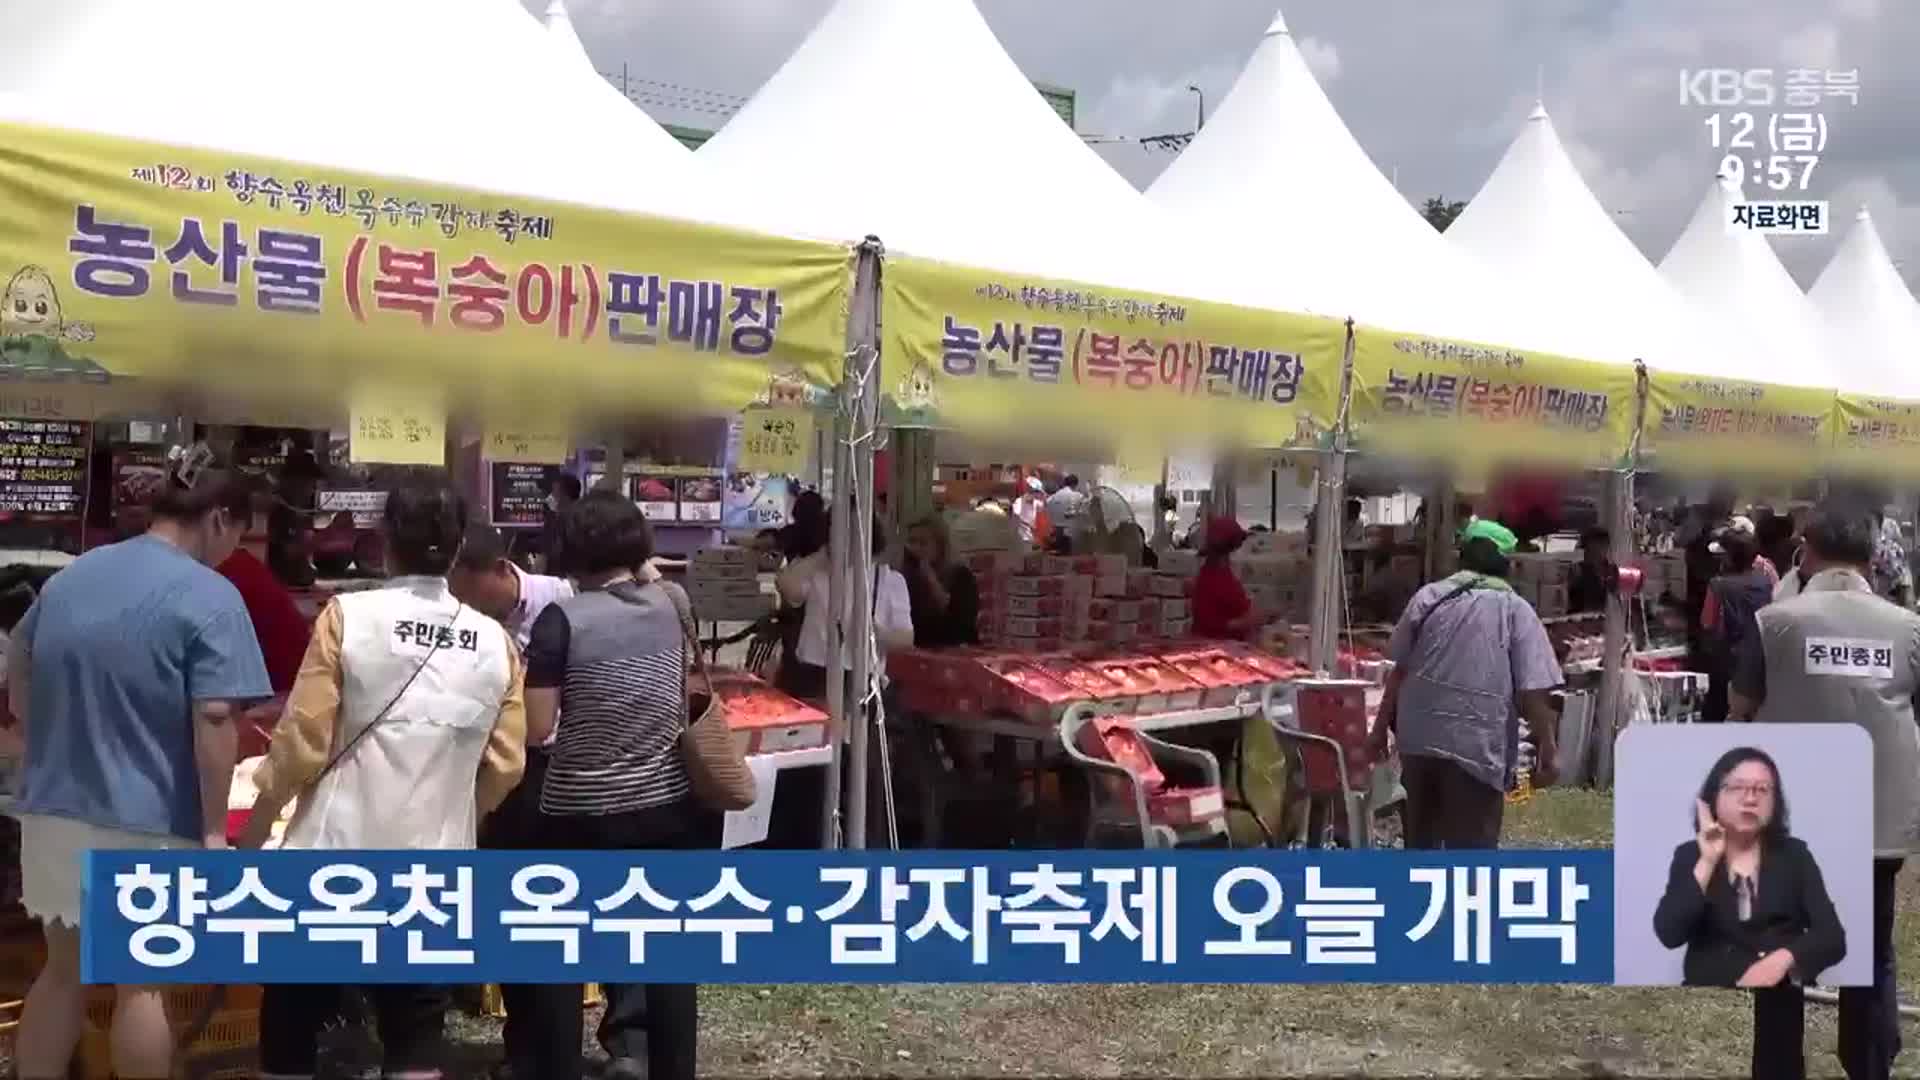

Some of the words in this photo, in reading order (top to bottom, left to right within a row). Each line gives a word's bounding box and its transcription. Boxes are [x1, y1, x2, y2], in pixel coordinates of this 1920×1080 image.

[131, 164, 216, 192] 제12회
[69, 205, 327, 313] 농산물
[393, 620, 478, 652] 주민총회
[1808, 644, 1892, 668] 주민총회
